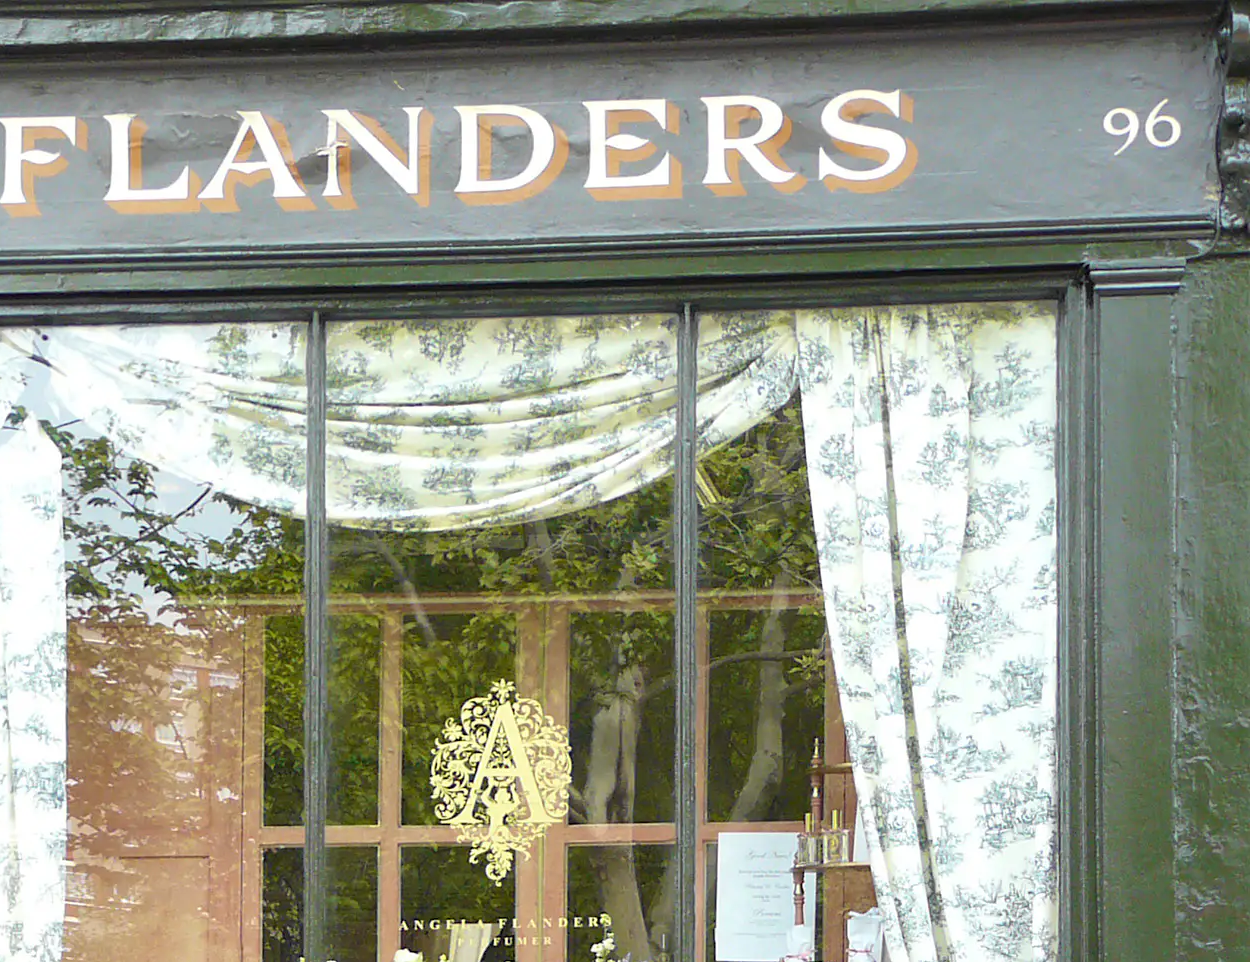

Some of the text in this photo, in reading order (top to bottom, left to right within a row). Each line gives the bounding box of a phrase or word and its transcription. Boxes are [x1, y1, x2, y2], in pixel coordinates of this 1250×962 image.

[1103, 98, 1181, 156] 96
[398, 915, 612, 931] ANGELA FLANDERS
[458, 936, 552, 947] PFUMER
